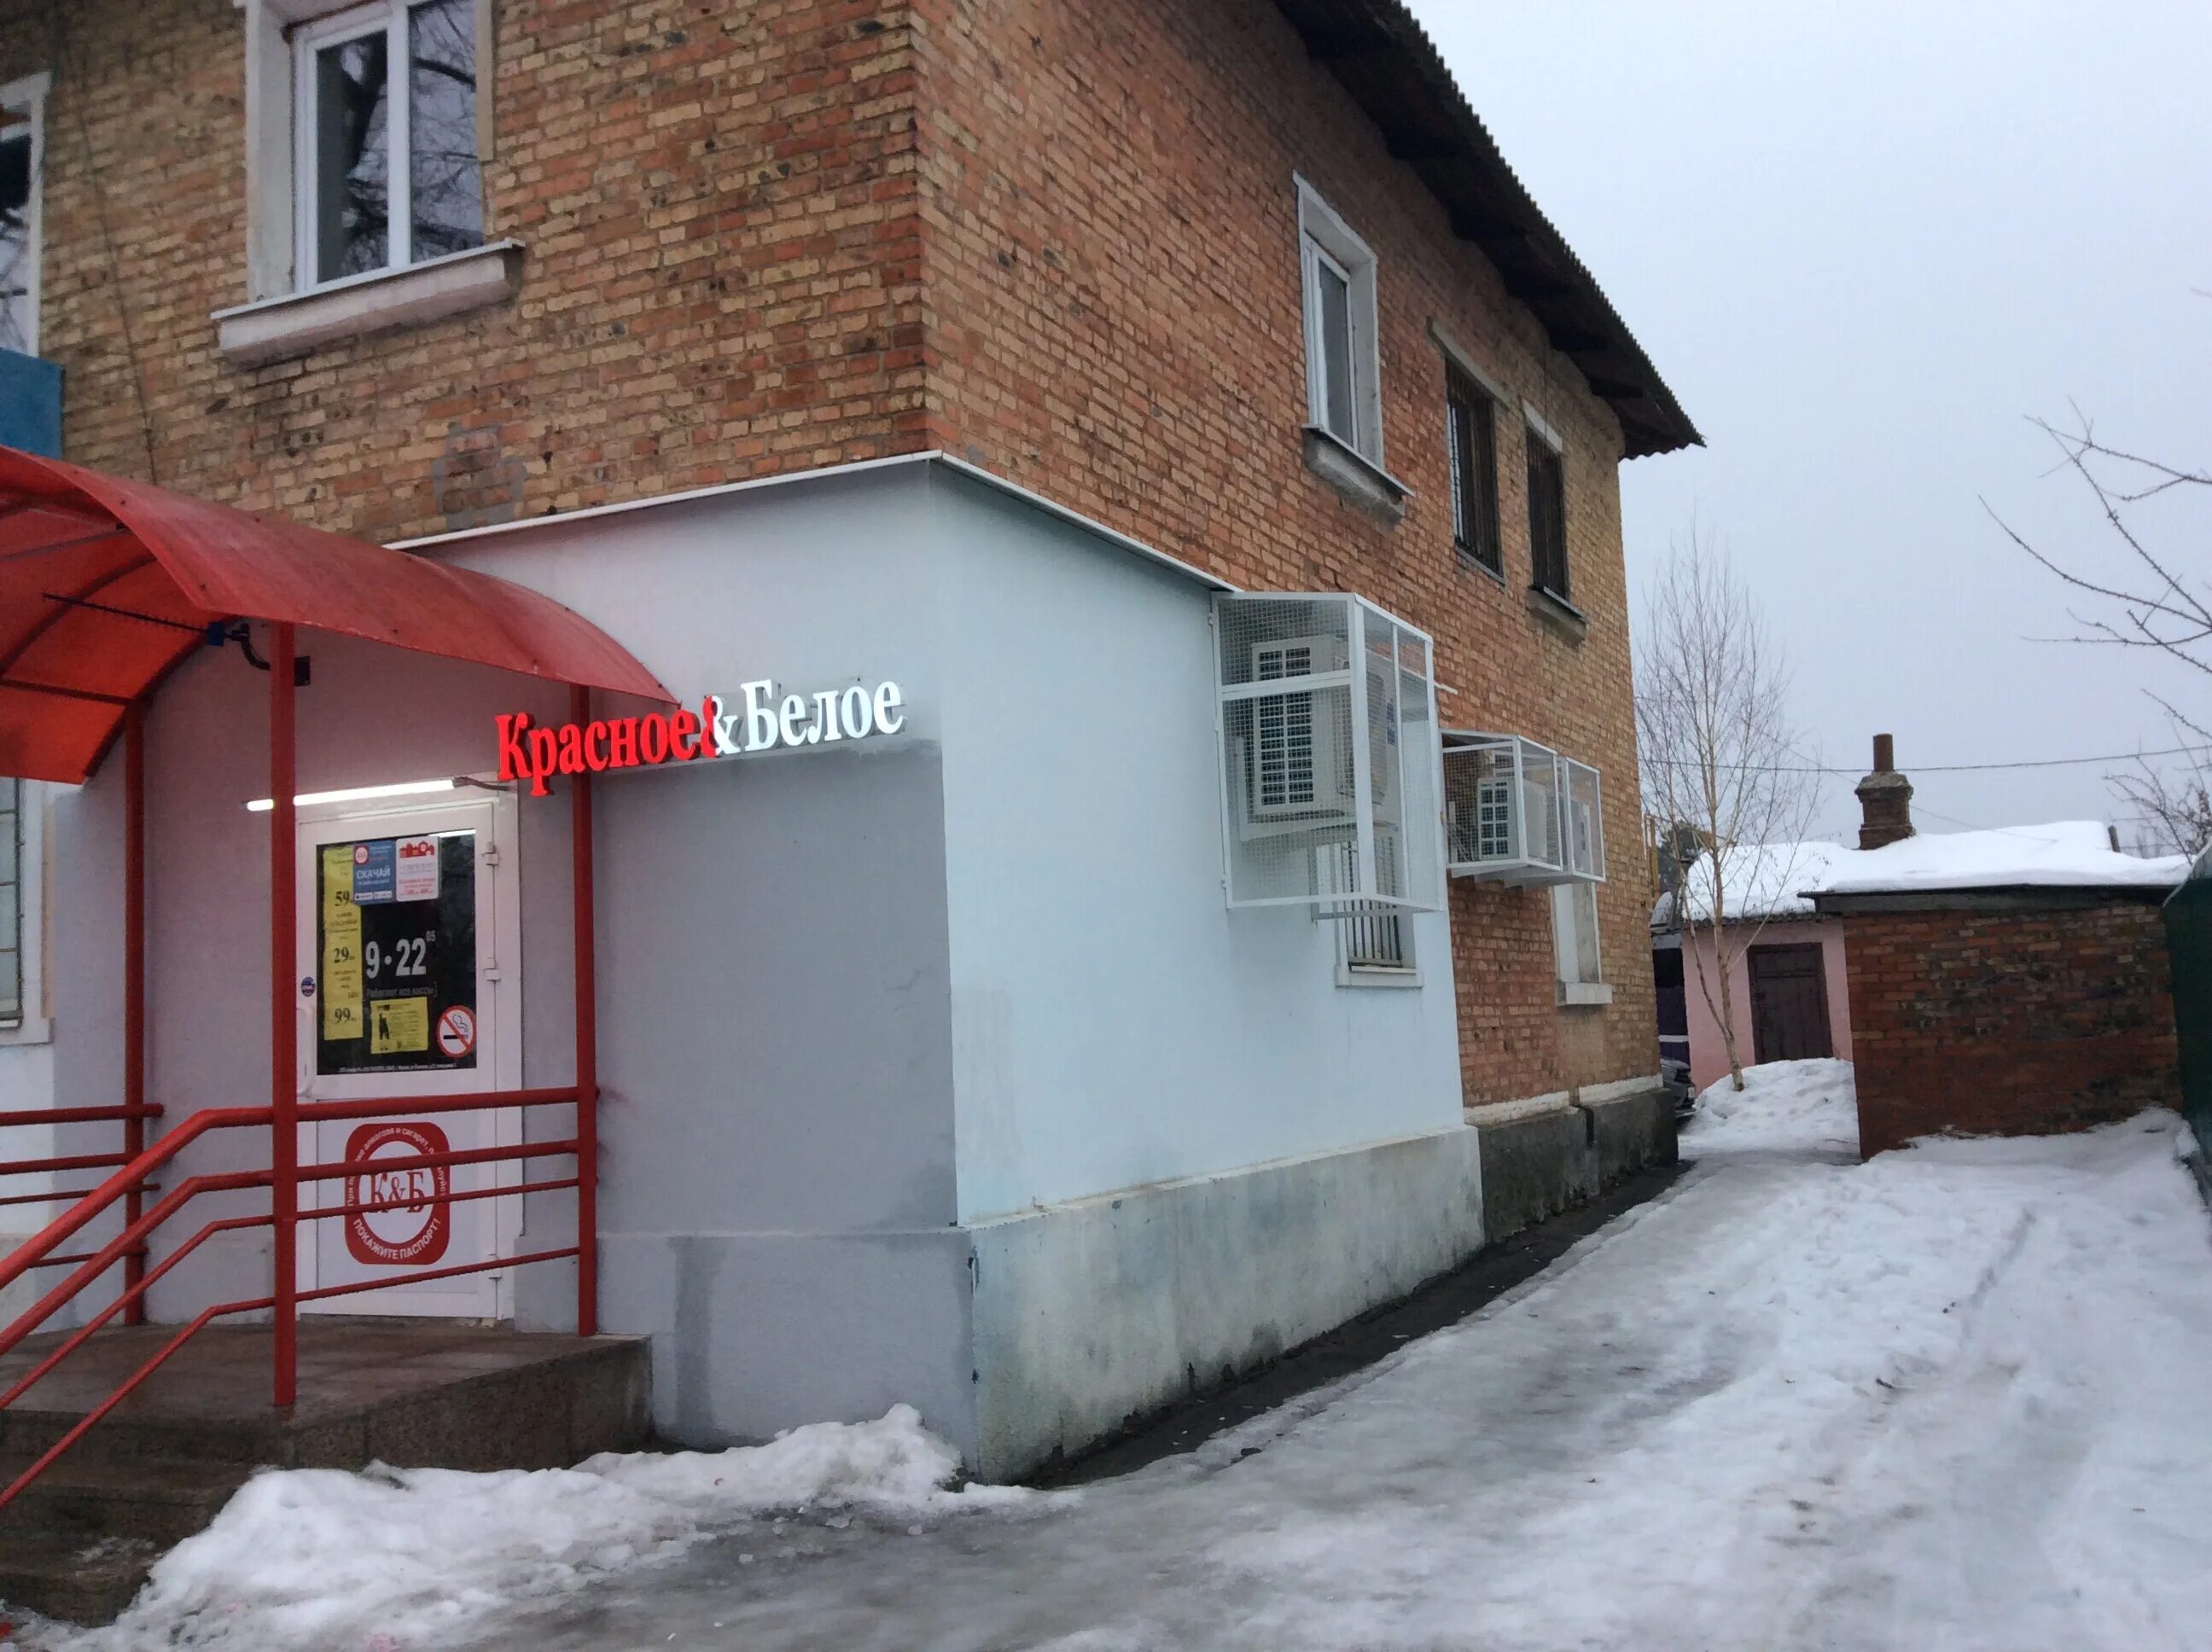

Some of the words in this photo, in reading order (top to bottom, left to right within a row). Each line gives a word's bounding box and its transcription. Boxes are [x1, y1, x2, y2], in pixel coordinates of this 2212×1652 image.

[356, 865, 391, 880] СКАЧАЙ
[334, 1008, 351, 1024] 99
[352, 1218, 399, 1259] ПОКАЖИТЕ
